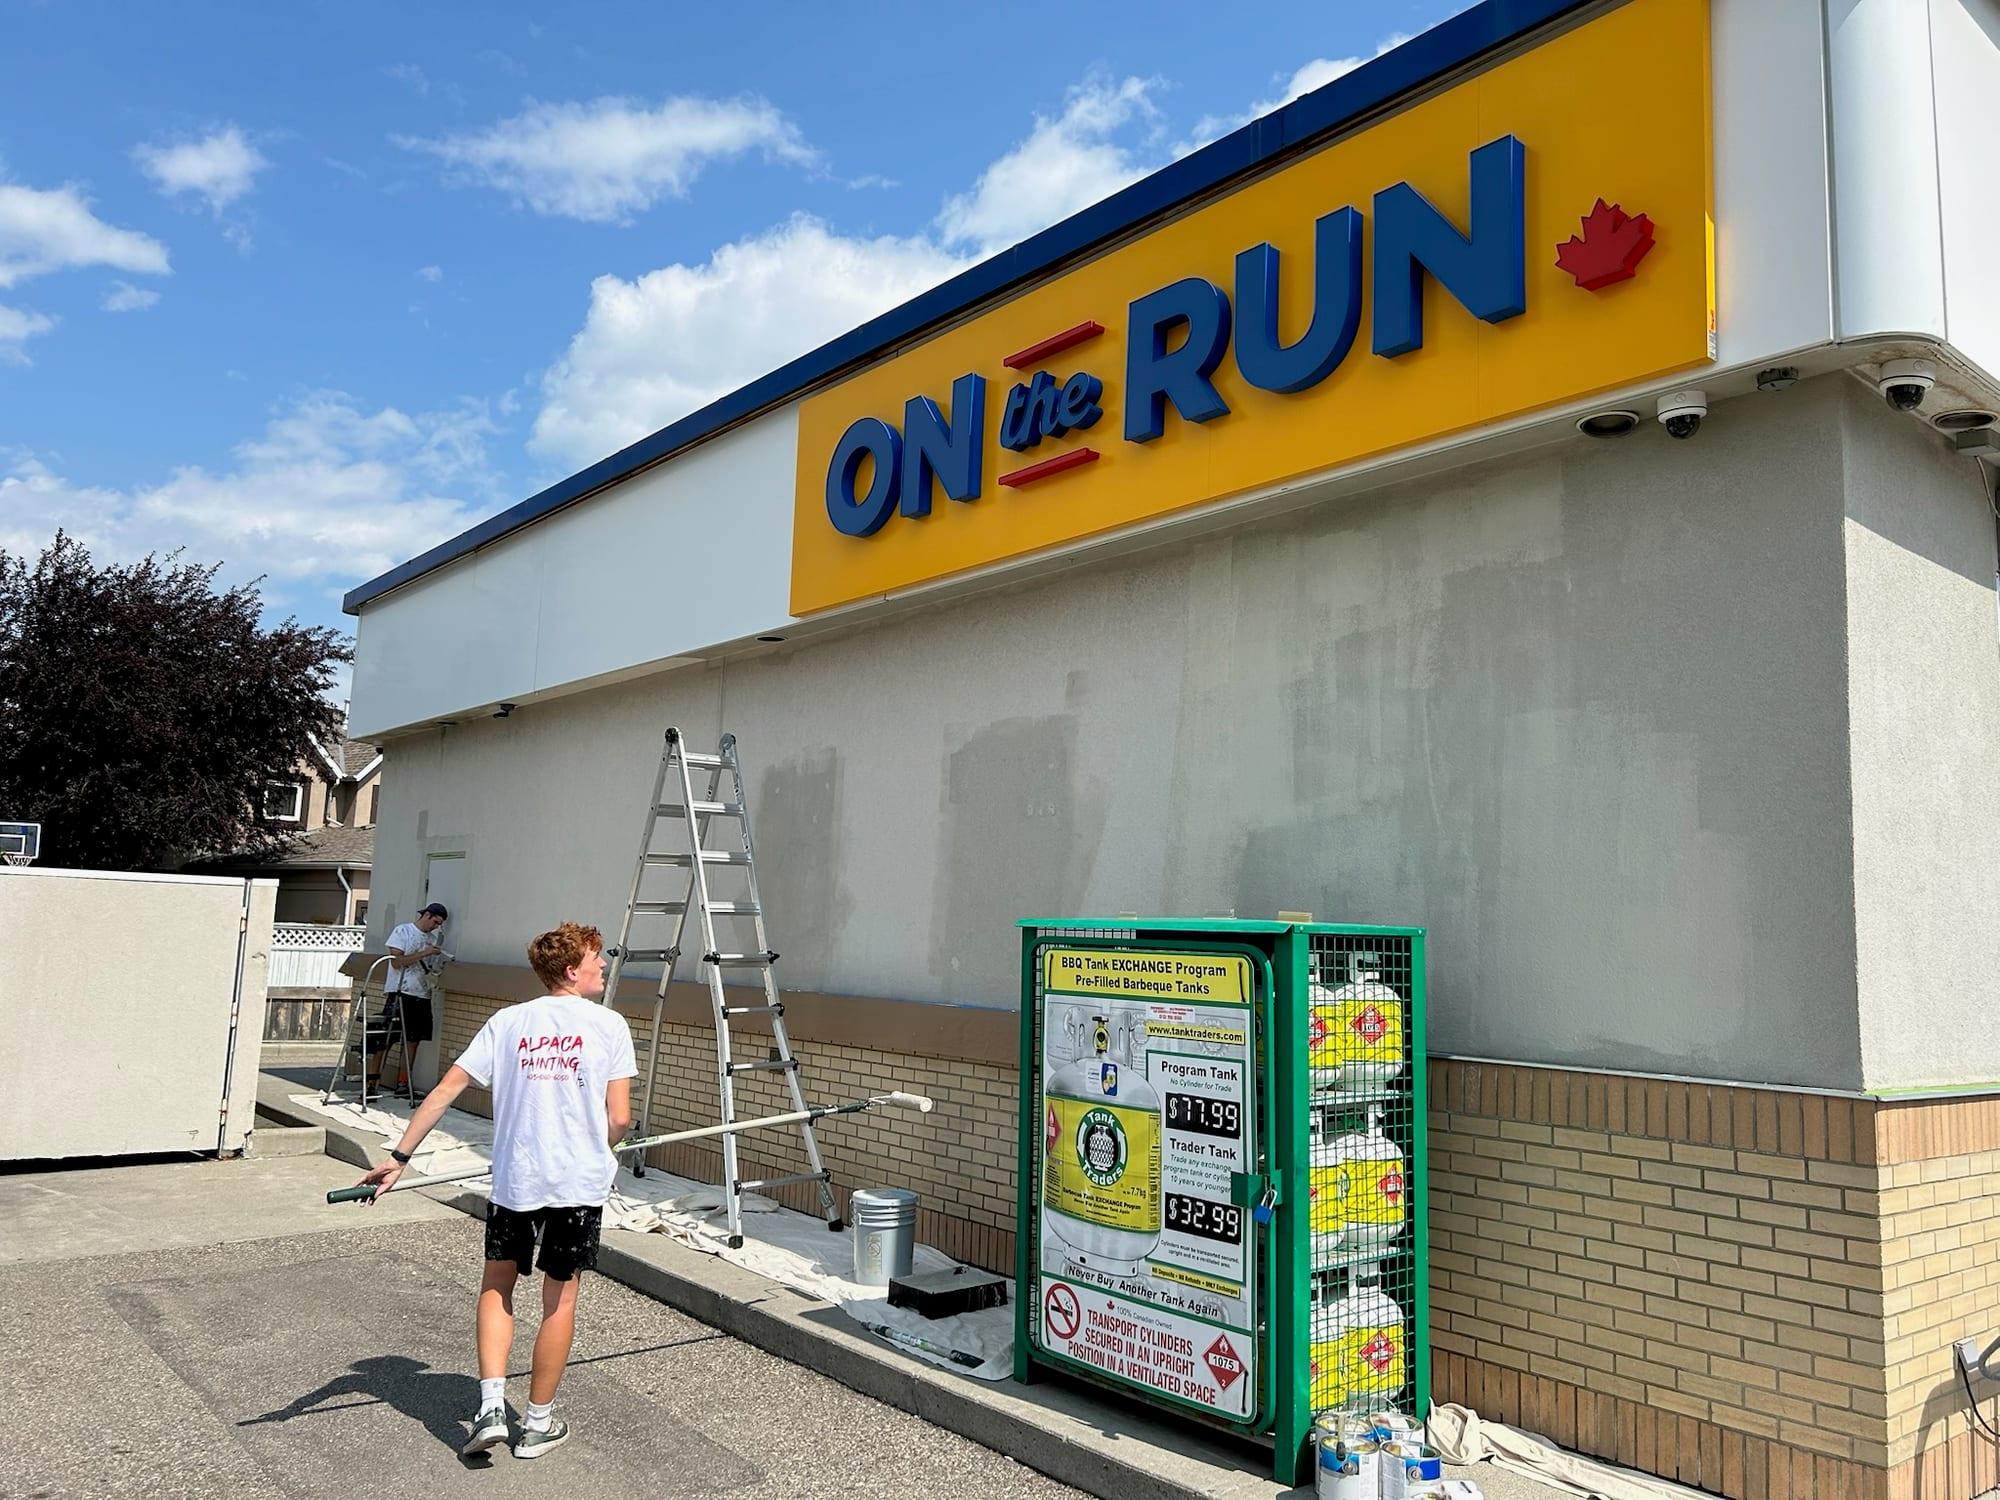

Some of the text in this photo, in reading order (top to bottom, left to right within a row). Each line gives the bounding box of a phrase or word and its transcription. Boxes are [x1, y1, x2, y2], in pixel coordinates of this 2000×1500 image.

[825, 133, 1526, 537] ON the RUN
[1062, 957, 1227, 978] BBQ Tank EXCHANGE Program
[1076, 975, 1210, 994] Pre-Filled Barbeque Tanks
[1148, 1026, 1242, 1042] www.tanktraders.com
[517, 1035, 583, 1053] ALPACA
[521, 1057, 580, 1072] PAINTING
[1161, 1061, 1238, 1081] Program Tank
[1180, 1079, 1203, 1089] Cylinder
[1204, 1081, 1213, 1089] for
[1215, 1083, 1232, 1092] Trade
[1087, 1111, 1115, 1127] Tank
[1169, 1097, 1238, 1131] $77.99
[1169, 1137, 1238, 1160] Trader Tank
[1083, 1160, 1123, 1186] Traders
[1163, 1164, 1189, 1174] program
[1189, 1168, 1203, 1177] tank
[1171, 1154, 1232, 1173] Trade any exchange
[1171, 1175, 1178, 1183] 10
[1178, 1177, 1195, 1186] years
[1204, 1183, 1232, 1194] younger
[1095, 1194, 1123, 1208] EXCHANGE
[1169, 1198, 1238, 1237] $32.99
[1068, 1265, 1219, 1317] Never Buy Another Tank Again
[1116, 1306, 1173, 1330] 100% Canadian Owned
[1087, 1309, 1193, 1357] TRANSPORT CYLINDERS
[1085, 1327, 1195, 1378] SECURED IN AN UPRIGHT
[1213, 1355, 1235, 1370] 1075
[1068, 1340, 1216, 1405] POSITION IN A VENTILATED SPACE
[1221, 1379, 1226, 1387] 2
